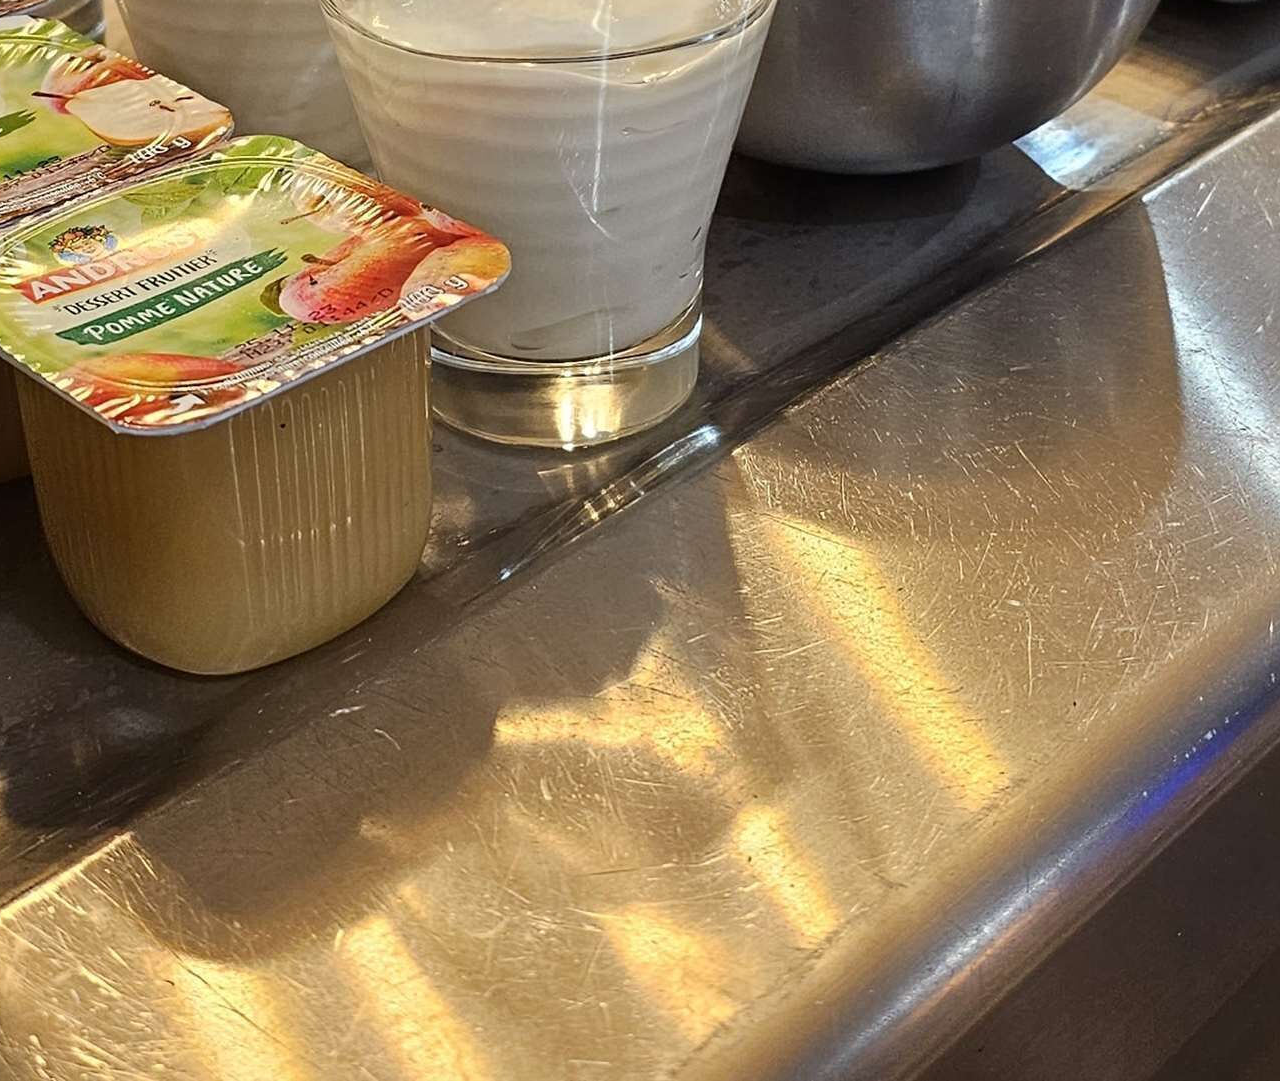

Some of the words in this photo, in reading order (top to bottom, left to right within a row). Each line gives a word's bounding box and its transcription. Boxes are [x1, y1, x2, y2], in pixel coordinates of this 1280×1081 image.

[29, 227, 207, 301] ANDROS
[61, 279, 138, 316] DESSERT
[139, 252, 215, 292] FRUITIER
[82, 300, 175, 340] POMME
[177, 259, 265, 307] NATURE
